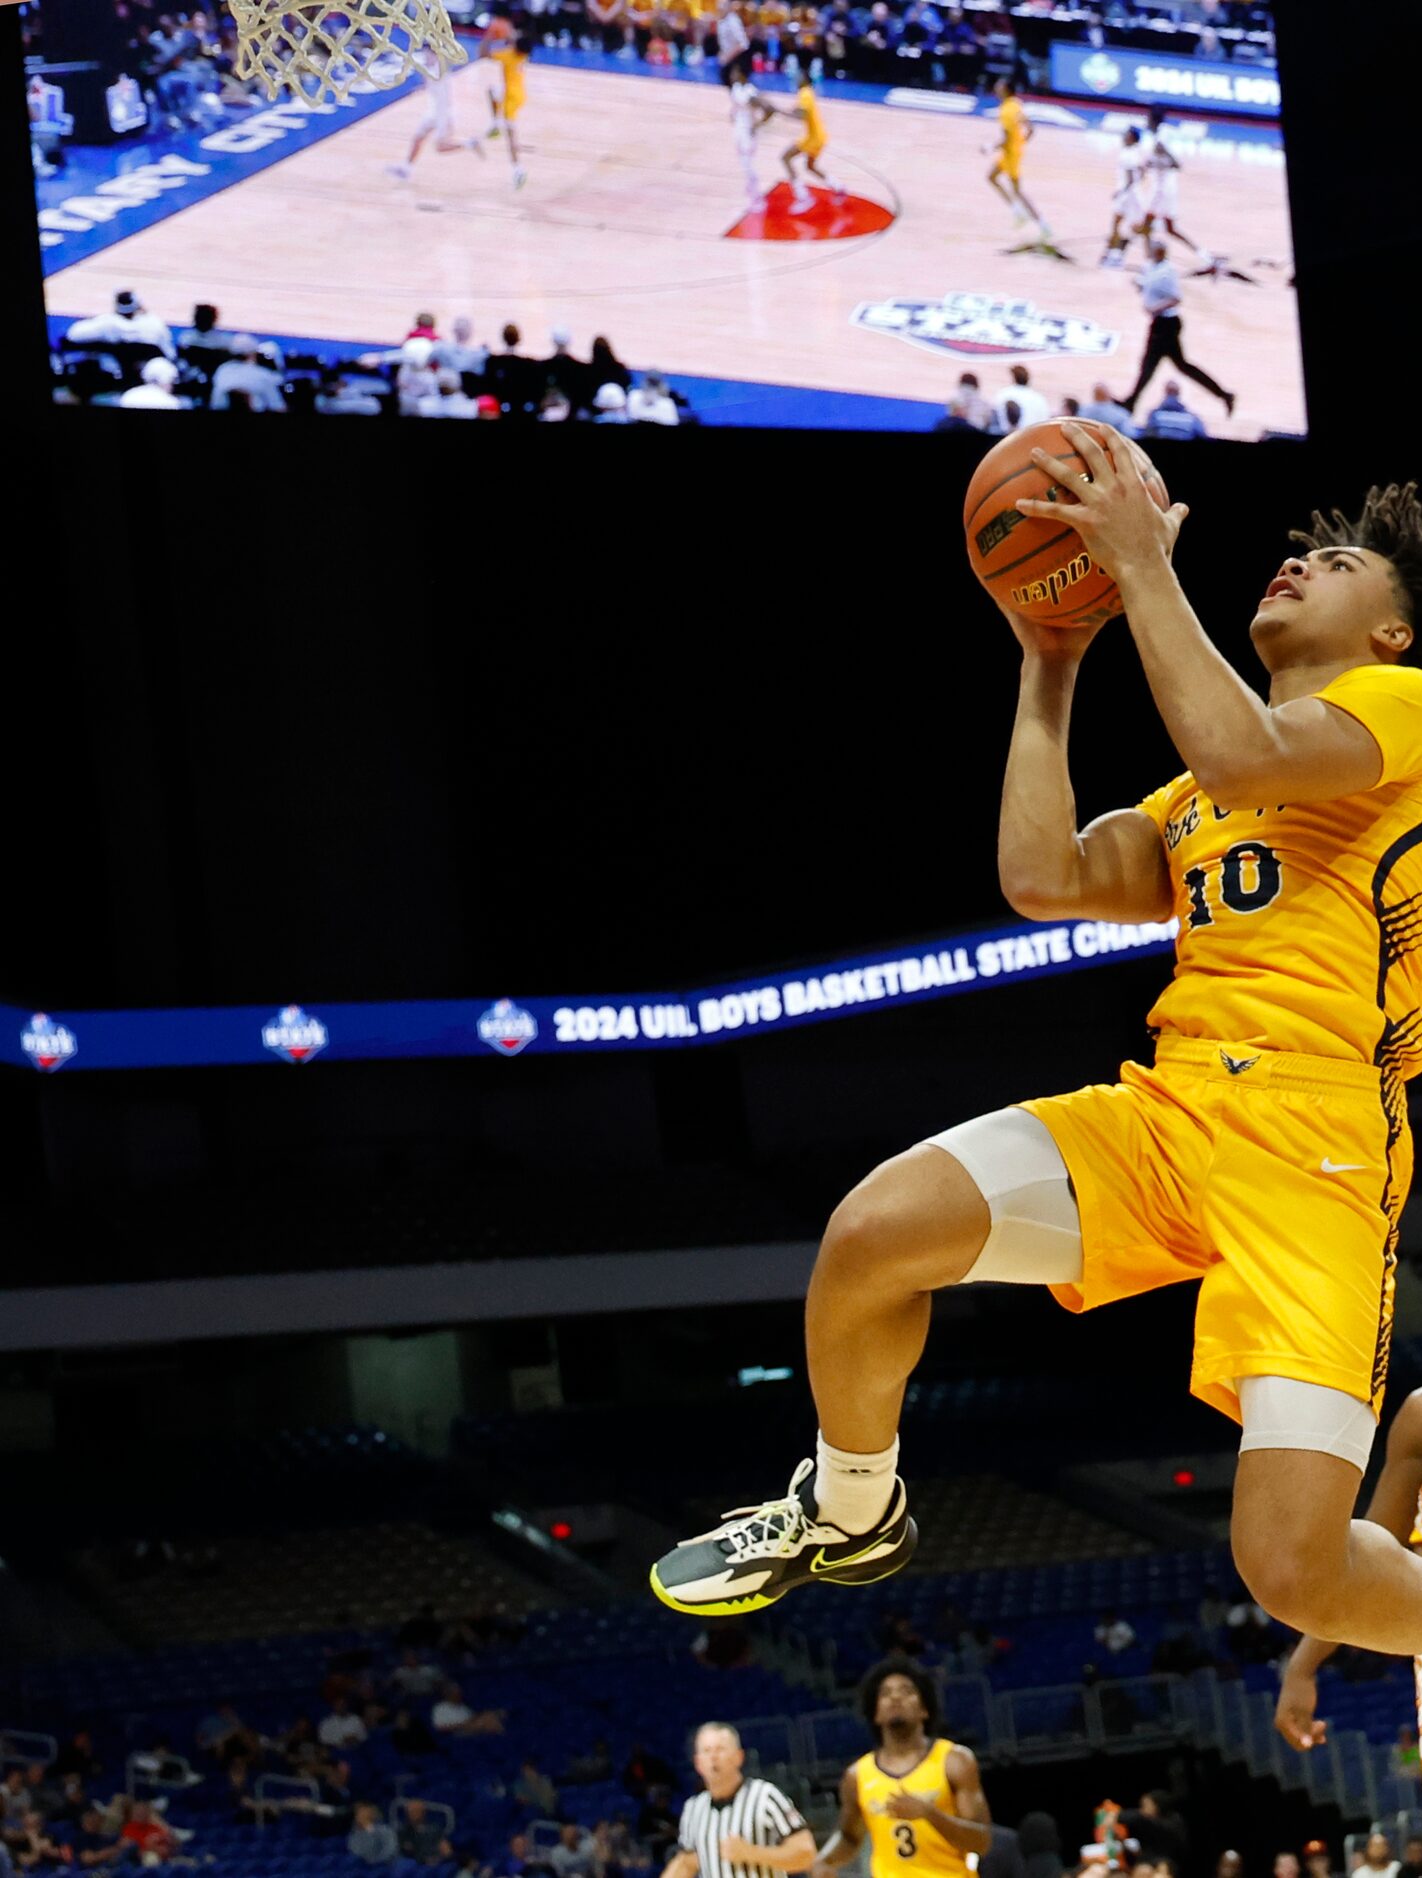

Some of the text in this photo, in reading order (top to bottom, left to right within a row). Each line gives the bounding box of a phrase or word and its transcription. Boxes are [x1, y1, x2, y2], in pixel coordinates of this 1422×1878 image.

[1011, 551, 1107, 606] aden
[1184, 839, 1282, 928] 10
[553, 1005, 639, 1043] 2024
[639, 1003, 699, 1040] UIL
[698, 986, 782, 1035] BOYS
[782, 946, 976, 1017] BASKETBALL
[976, 926, 1072, 977] STATE
[895, 1824, 917, 1859] 3
